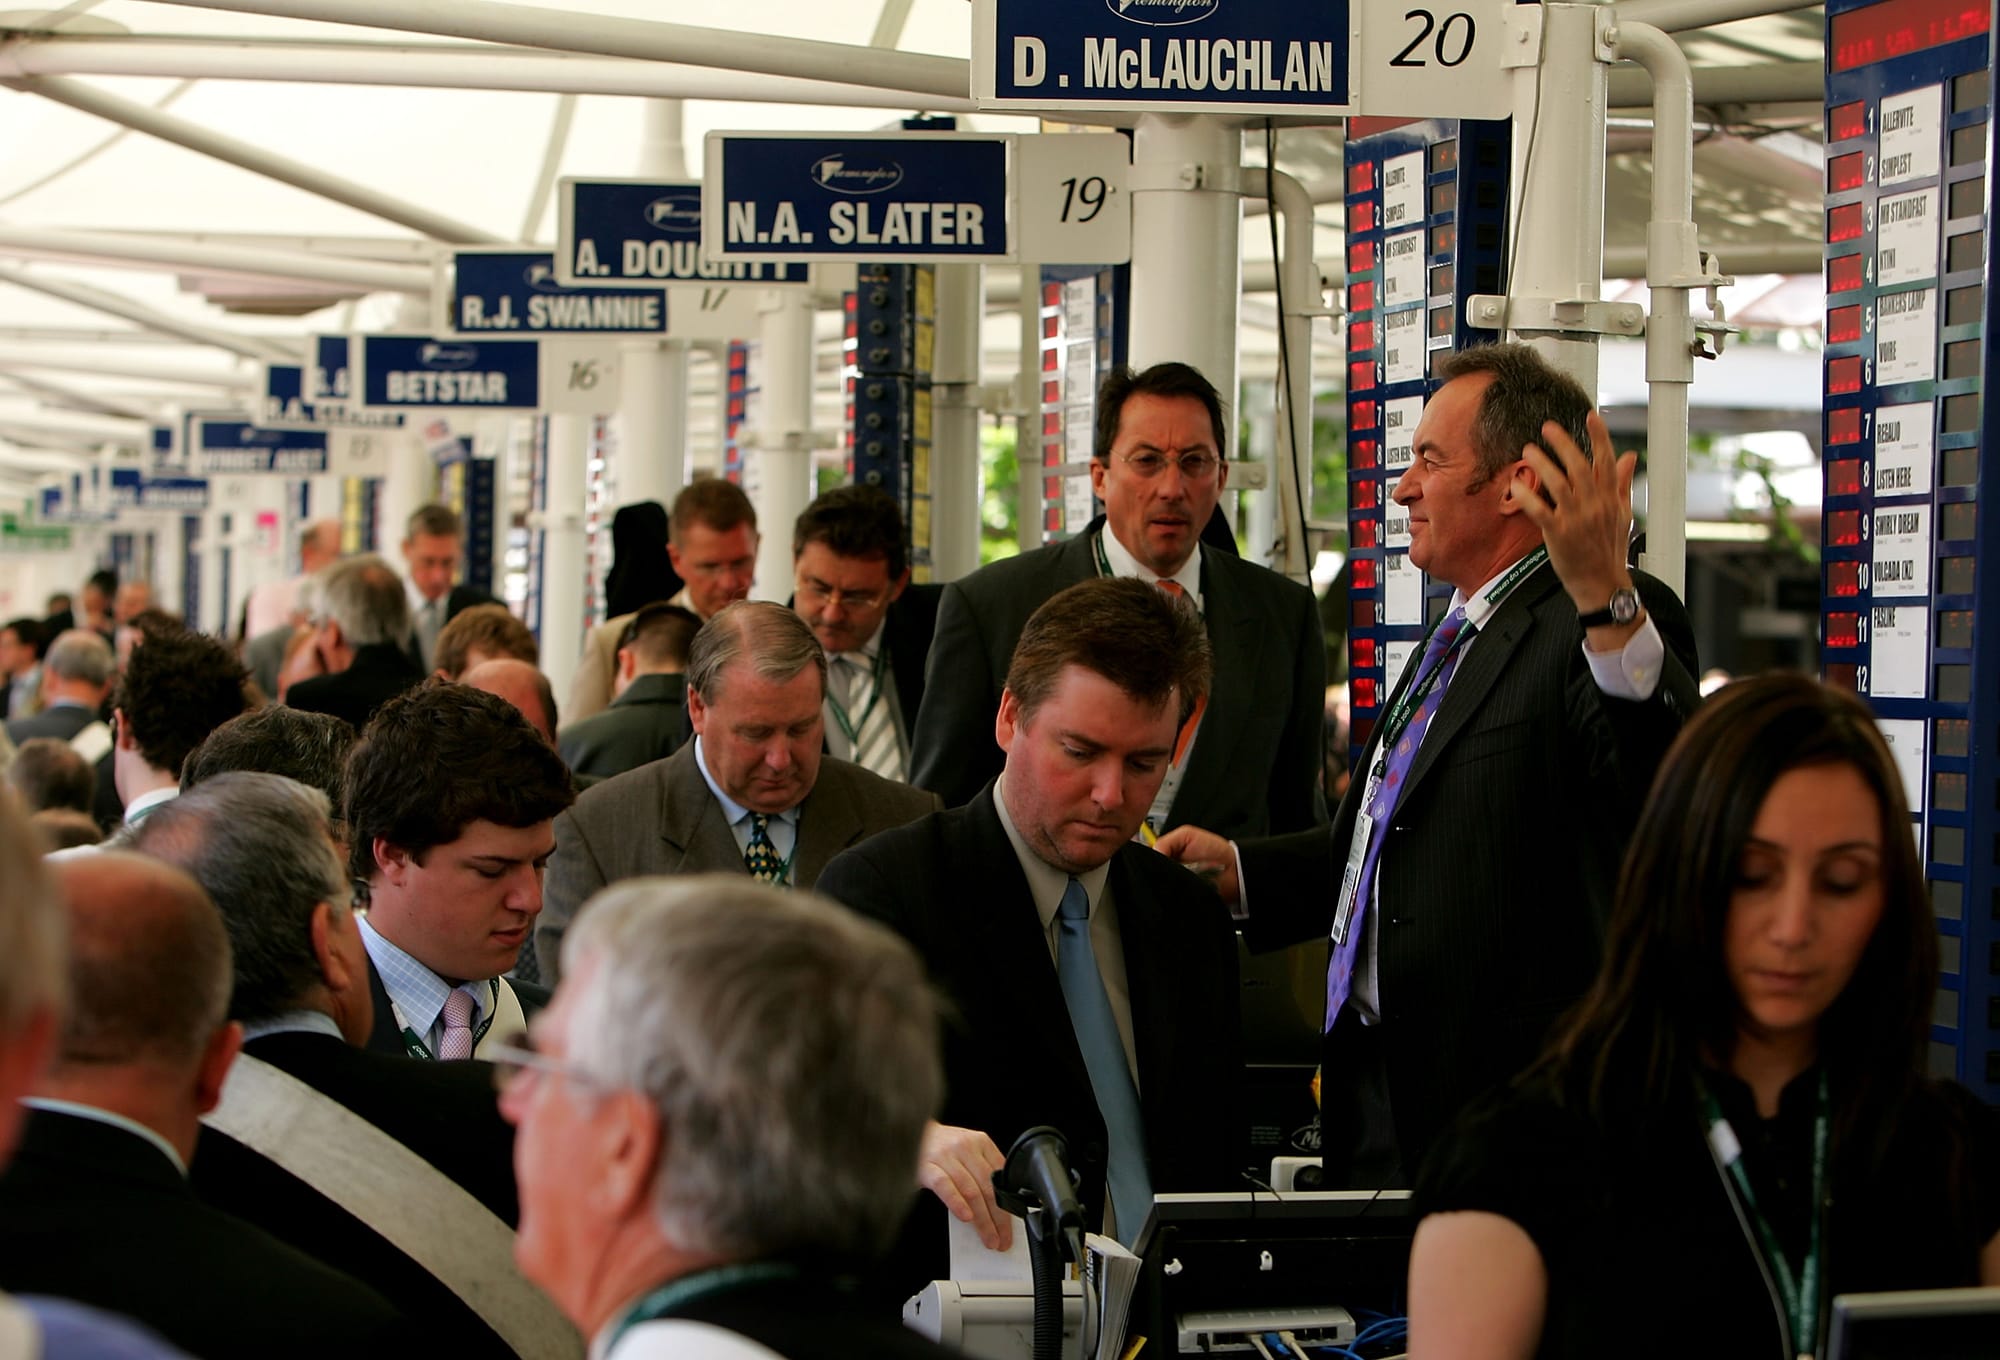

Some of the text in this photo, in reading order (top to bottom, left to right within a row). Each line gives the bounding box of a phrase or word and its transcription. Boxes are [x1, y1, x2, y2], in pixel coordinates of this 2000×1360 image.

[1389, 9, 1476, 67] 20
[1084, 37, 1332, 92] McLAUCHLAN
[1867, 107, 1875, 134] 1
[1374, 167, 1380, 189] 1
[1867, 156, 1874, 182] 2
[1881, 152, 1912, 179] SIMPLEST
[1058, 177, 1107, 223] 19
[1890, 195, 1927, 223] STANDFAST
[728, 201, 813, 244] N.A.
[829, 201, 984, 246] SLATER
[1374, 205, 1381, 227] 2
[1866, 206, 1874, 232] 3
[575, 239, 611, 276] A.
[1375, 242, 1381, 264] 3
[1865, 256, 1874, 283] 4
[461, 295, 661, 329] R.J. SWANNIE
[1865, 306, 1873, 333] 5
[568, 360, 600, 391] 16
[1376, 362, 1383, 384] 6
[1864, 358, 1872, 385] 6
[386, 370, 507, 403] BETSTAR
[1376, 405, 1383, 427] 7
[1864, 412, 1872, 440] 7
[1376, 444, 1383, 465] 8
[1863, 460, 1870, 488] 8
[1876, 466, 1912, 491] LISTEN HERE
[1376, 484, 1383, 505] 9
[1375, 523, 1384, 545] 10
[1862, 513, 1869, 541] 9
[1875, 512, 1920, 537] SWIRLY DREAM
[1375, 562, 1384, 584] 11
[1857, 562, 1869, 590] 10
[1374, 602, 1384, 624] 12
[1857, 615, 1868, 643] 11
[1374, 645, 1384, 668] 13
[1856, 665, 1868, 693] 12
[1374, 683, 1384, 704] 14
